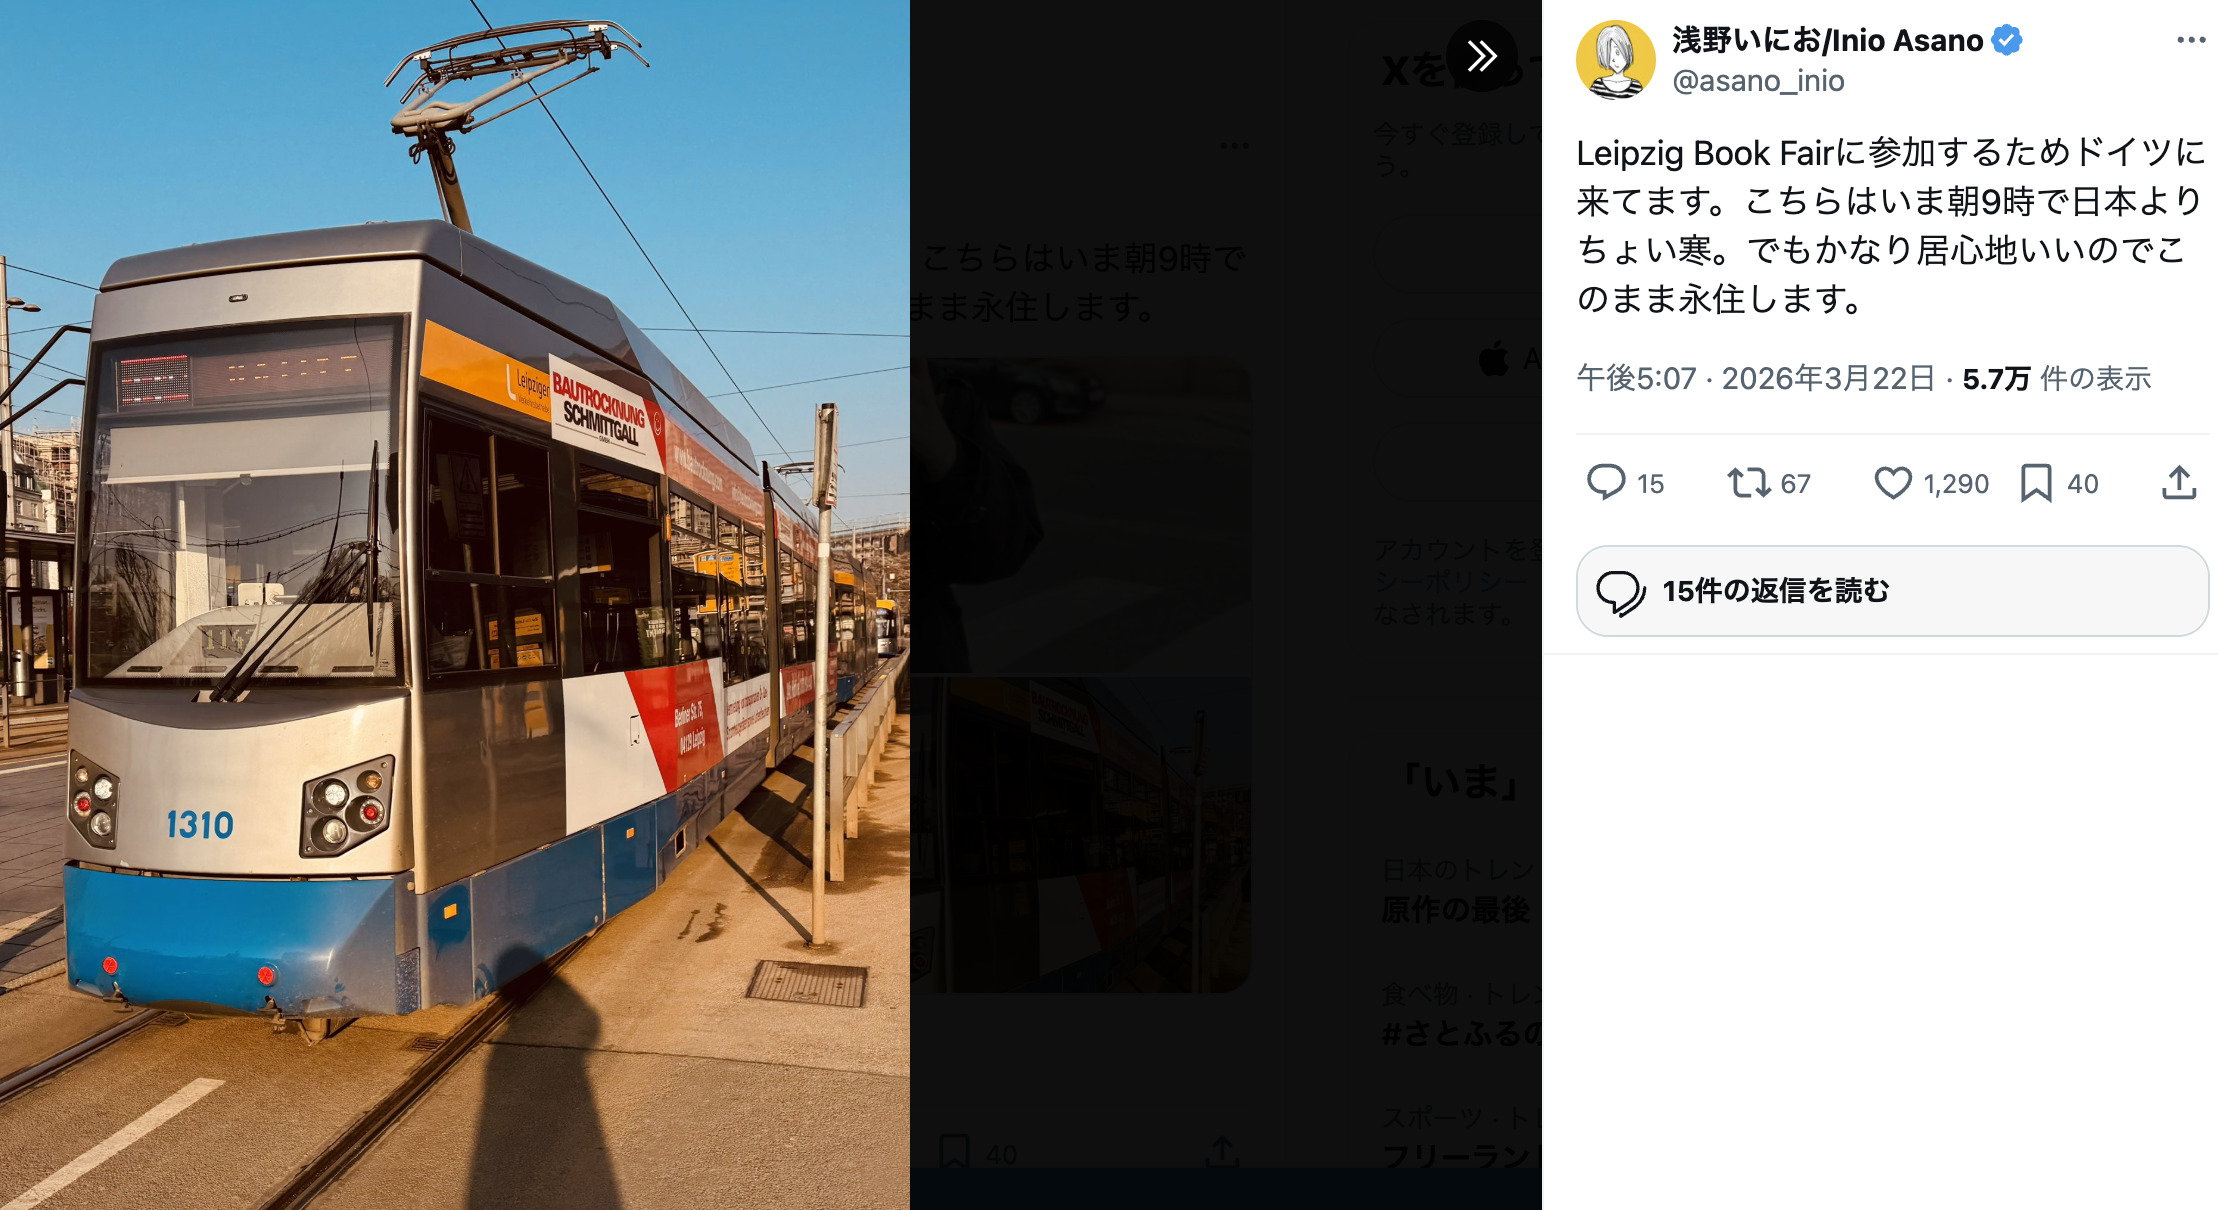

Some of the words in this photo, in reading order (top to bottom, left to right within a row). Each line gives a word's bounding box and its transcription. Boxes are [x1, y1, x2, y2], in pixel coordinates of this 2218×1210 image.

[1673, 25, 1885, 57] 浅野いにお/Inio
[1893, 29, 1983, 53] Asano
[1674, 68, 1845, 96] @asano_inio
[1579, 139, 1683, 171] Leipzig
[1695, 139, 1770, 166] Book
[1578, 185, 2199, 217] 来てます。こちらはいま朝9時で日本より
[1580, 234, 2183, 266] ちょい寒。でもかなり居心地いいのでこ
[1579, 283, 1858, 315] のまま永住します。
[517, 368, 550, 398] Leipziger
[1577, 363, 1697, 392] 午後5:07
[1723, 363, 1932, 392] 2026年3月22日
[1964, 366, 2031, 391] 5.7万
[2041, 365, 2151, 391] 件の表示
[553, 371, 645, 429] BAUTROCKNUNG
[564, 400, 639, 447] SCHMITTGALL
[1638, 474, 1664, 494] 15
[1782, 474, 1810, 494] 67
[1925, 474, 1989, 499] 1,290
[2068, 474, 2098, 494] 40
[1664, 576, 1889, 604] 15件の返信を読む
[692, 728, 705, 751] Leipzig
[168, 810, 234, 840] 1310
[1383, 1144, 1541, 1168] フリーラン
